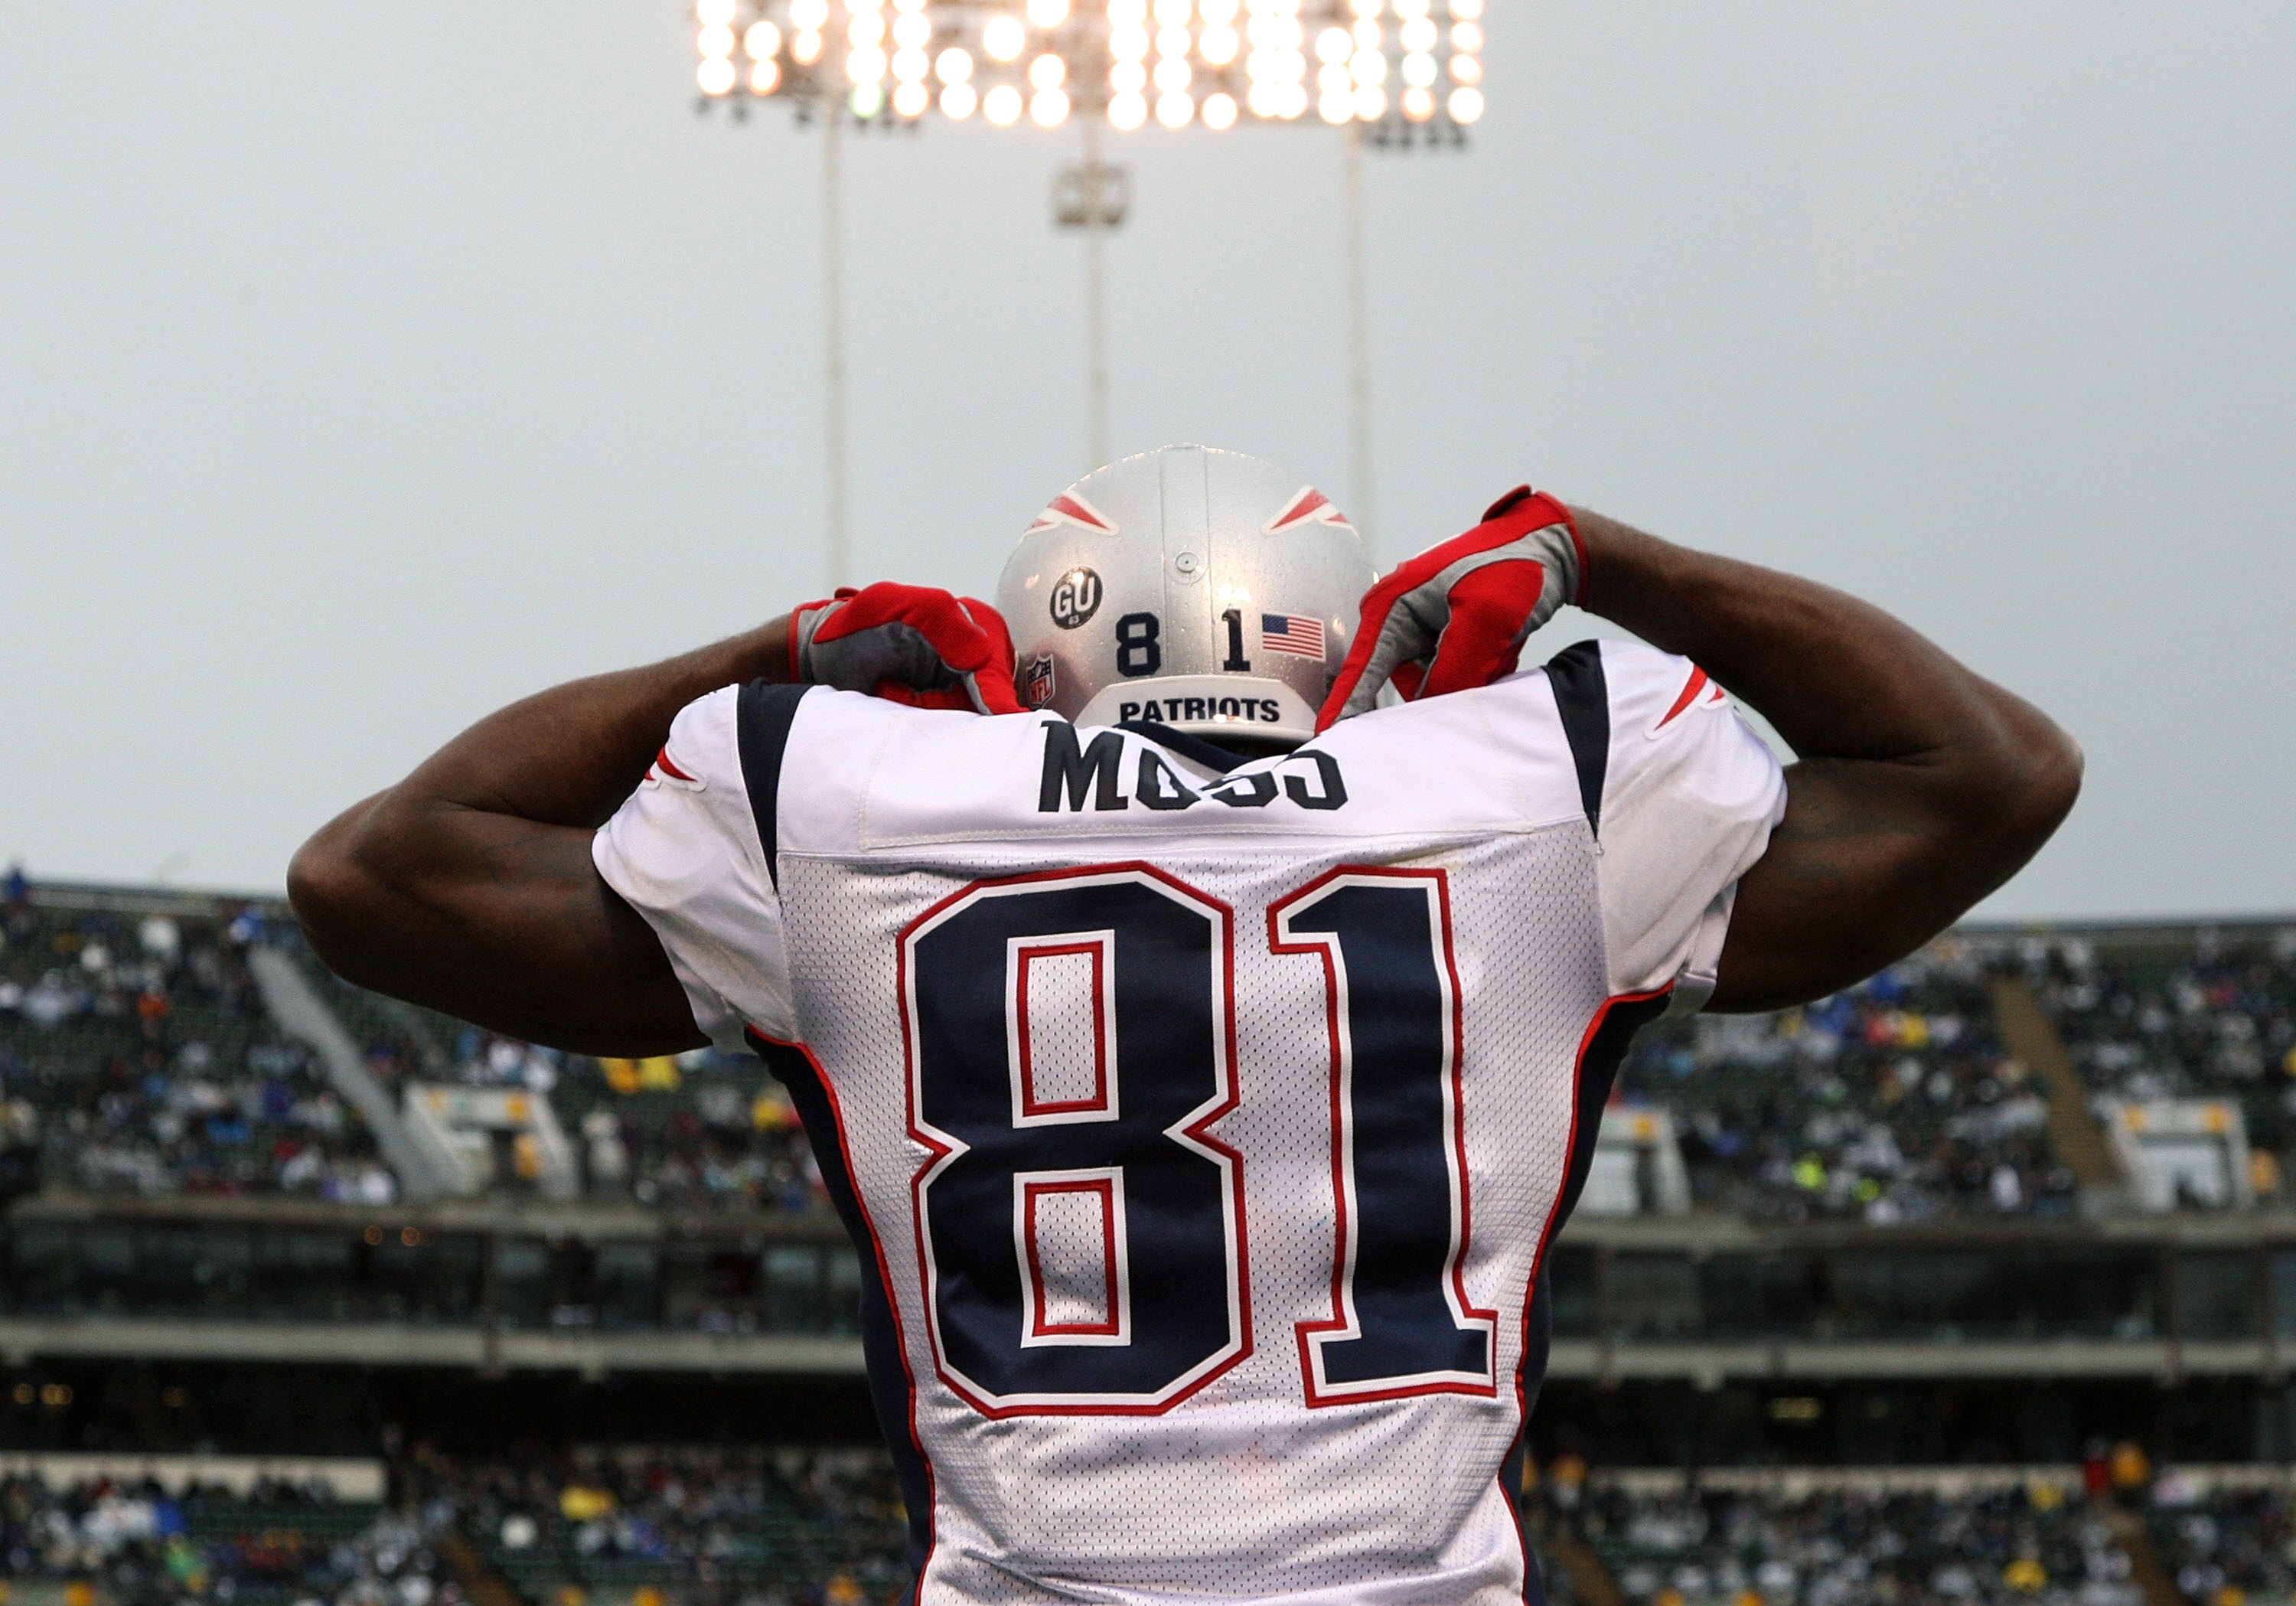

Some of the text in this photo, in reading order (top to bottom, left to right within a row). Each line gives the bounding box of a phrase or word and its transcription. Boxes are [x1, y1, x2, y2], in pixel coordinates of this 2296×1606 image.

[1055, 573, 1094, 618] GU
[1029, 674, 1052, 703] NFL
[1120, 697, 1280, 722] PATRIOTS
[896, 860, 1499, 1420] 81
